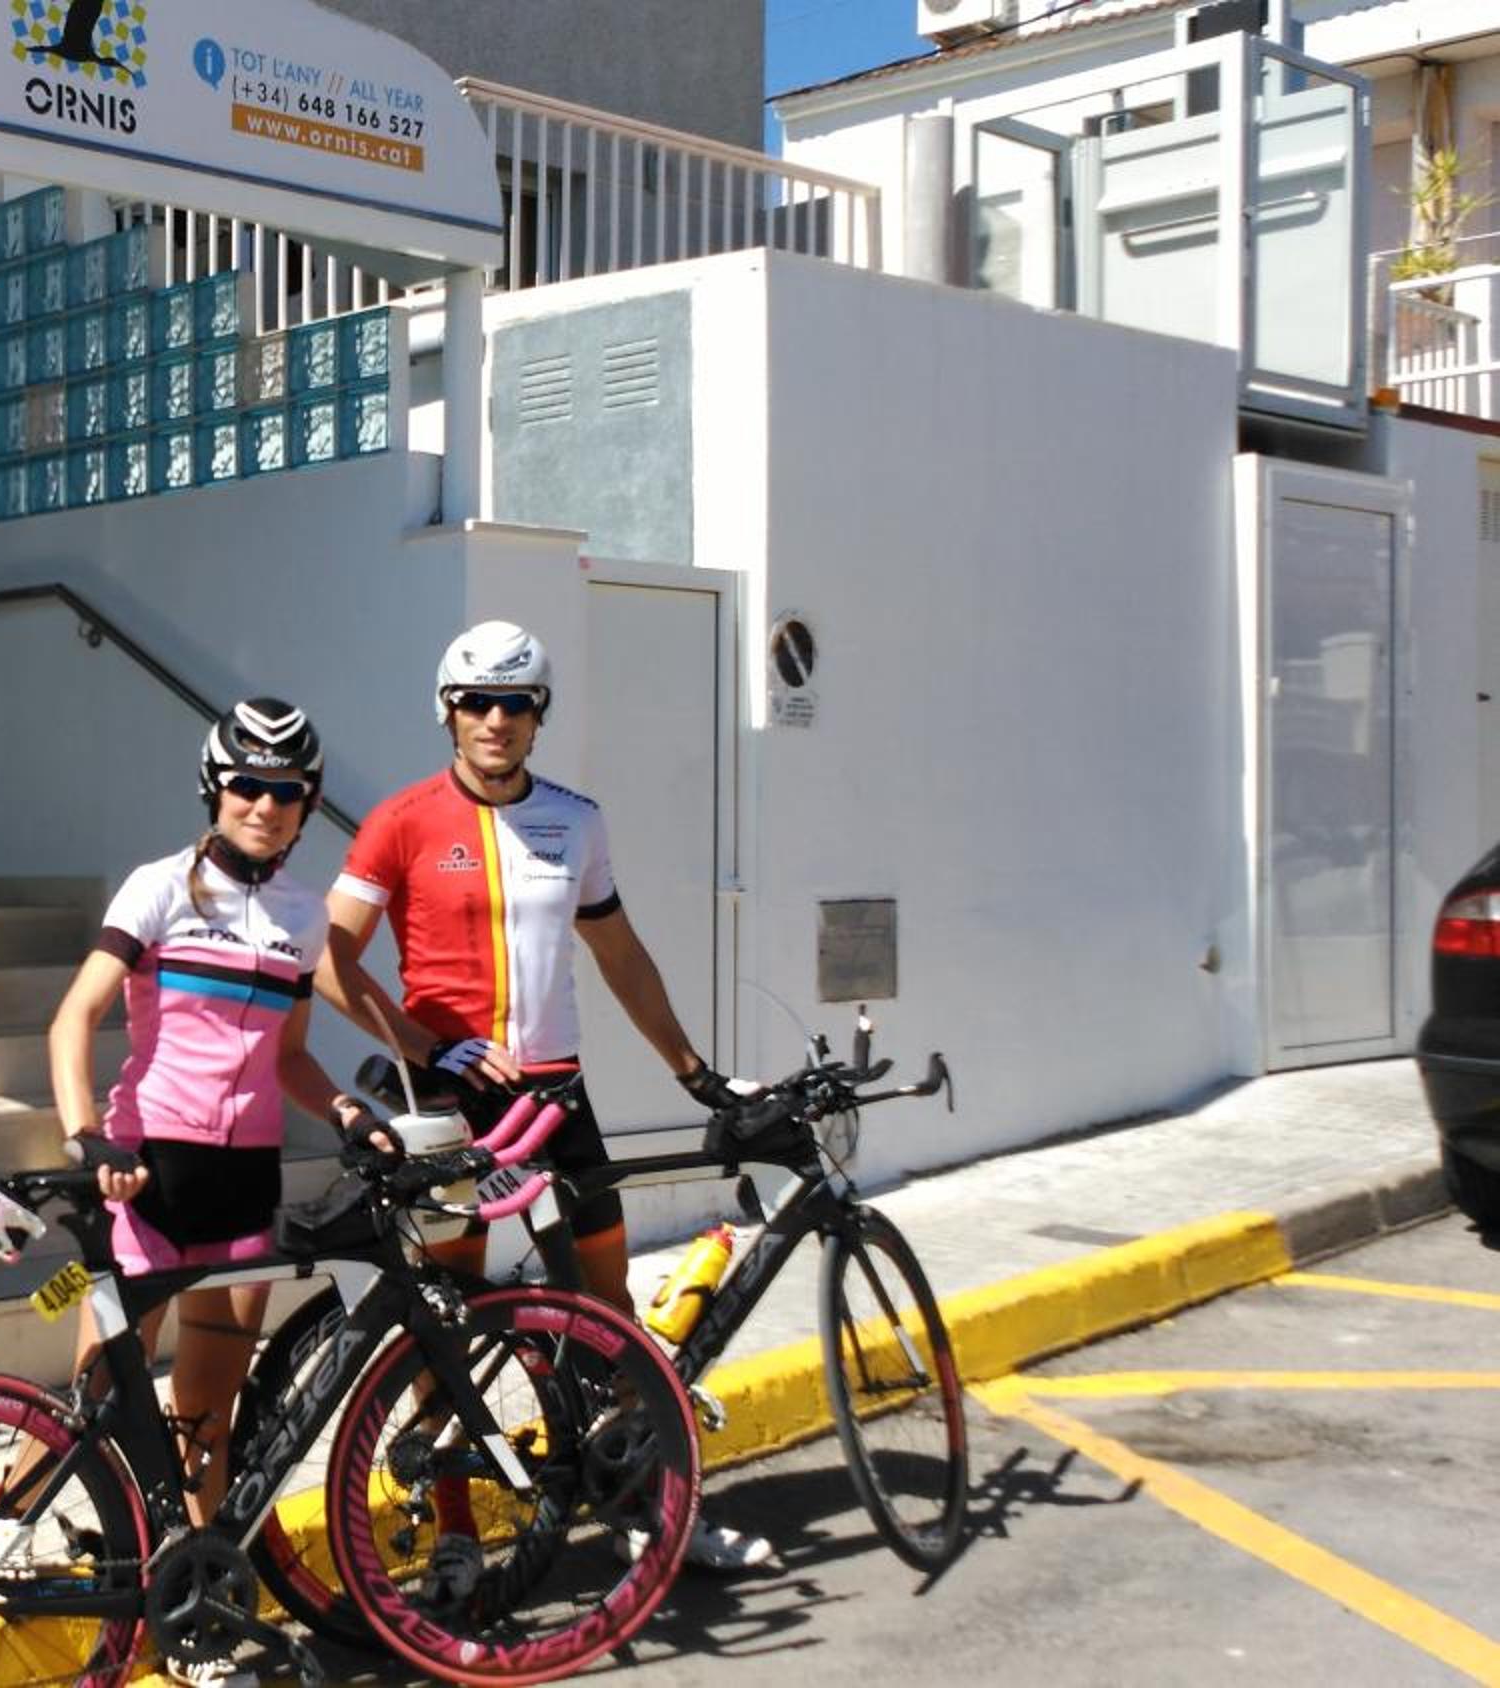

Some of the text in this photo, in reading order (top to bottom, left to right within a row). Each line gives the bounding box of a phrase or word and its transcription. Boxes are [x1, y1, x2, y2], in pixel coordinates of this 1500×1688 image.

[25, 78, 137, 134] ORNIS
[231, 76, 424, 140] (+34) 648 166 527
[232, 47, 267, 74] TOT
[350, 79, 379, 103] ALL
[384, 85, 424, 113] YEAR
[246, 114, 412, 166] www.ornis.cat
[245, 754, 293, 769] RUDY
[233, 1329, 368, 1521] ORBEA
